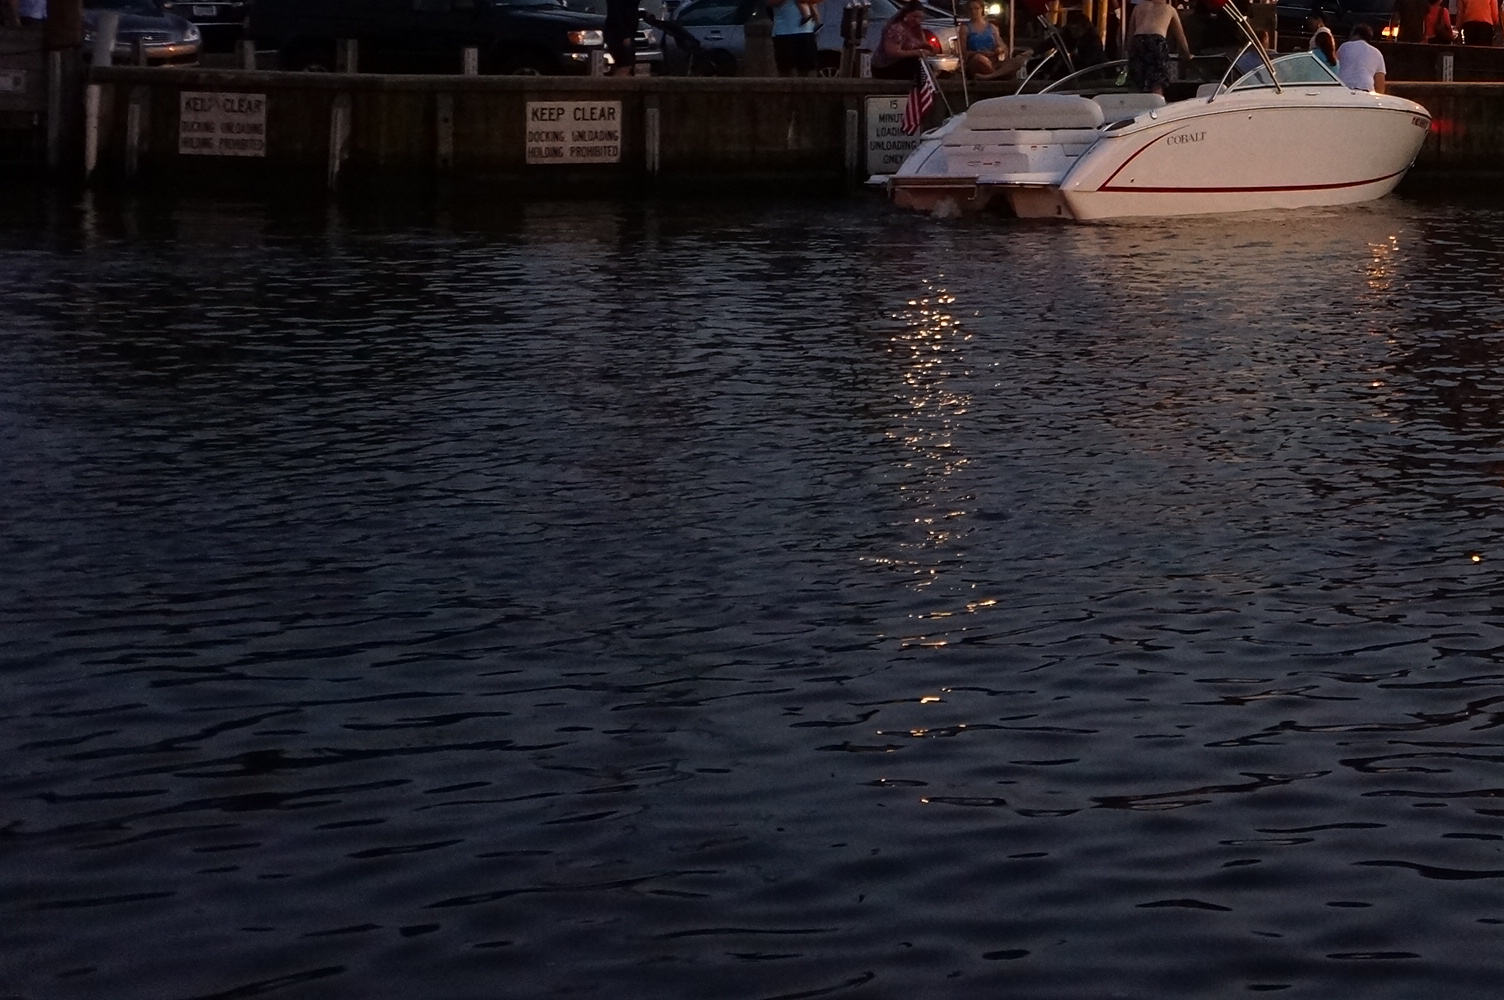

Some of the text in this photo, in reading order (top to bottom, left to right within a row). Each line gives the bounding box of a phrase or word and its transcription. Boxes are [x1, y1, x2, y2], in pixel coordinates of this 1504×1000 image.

[223, 98, 261, 113] CLEAR
[890, 100, 897, 109] 15
[532, 107, 616, 121] KEEP CLEAR
[879, 113, 903, 123] MINUT
[528, 130, 619, 142] DOCKING UNLOADING
[1166, 131, 1208, 146] COBALT
[528, 145, 618, 158] HOLDING PROHIBITED
[870, 140, 917, 151] UNLOADING
